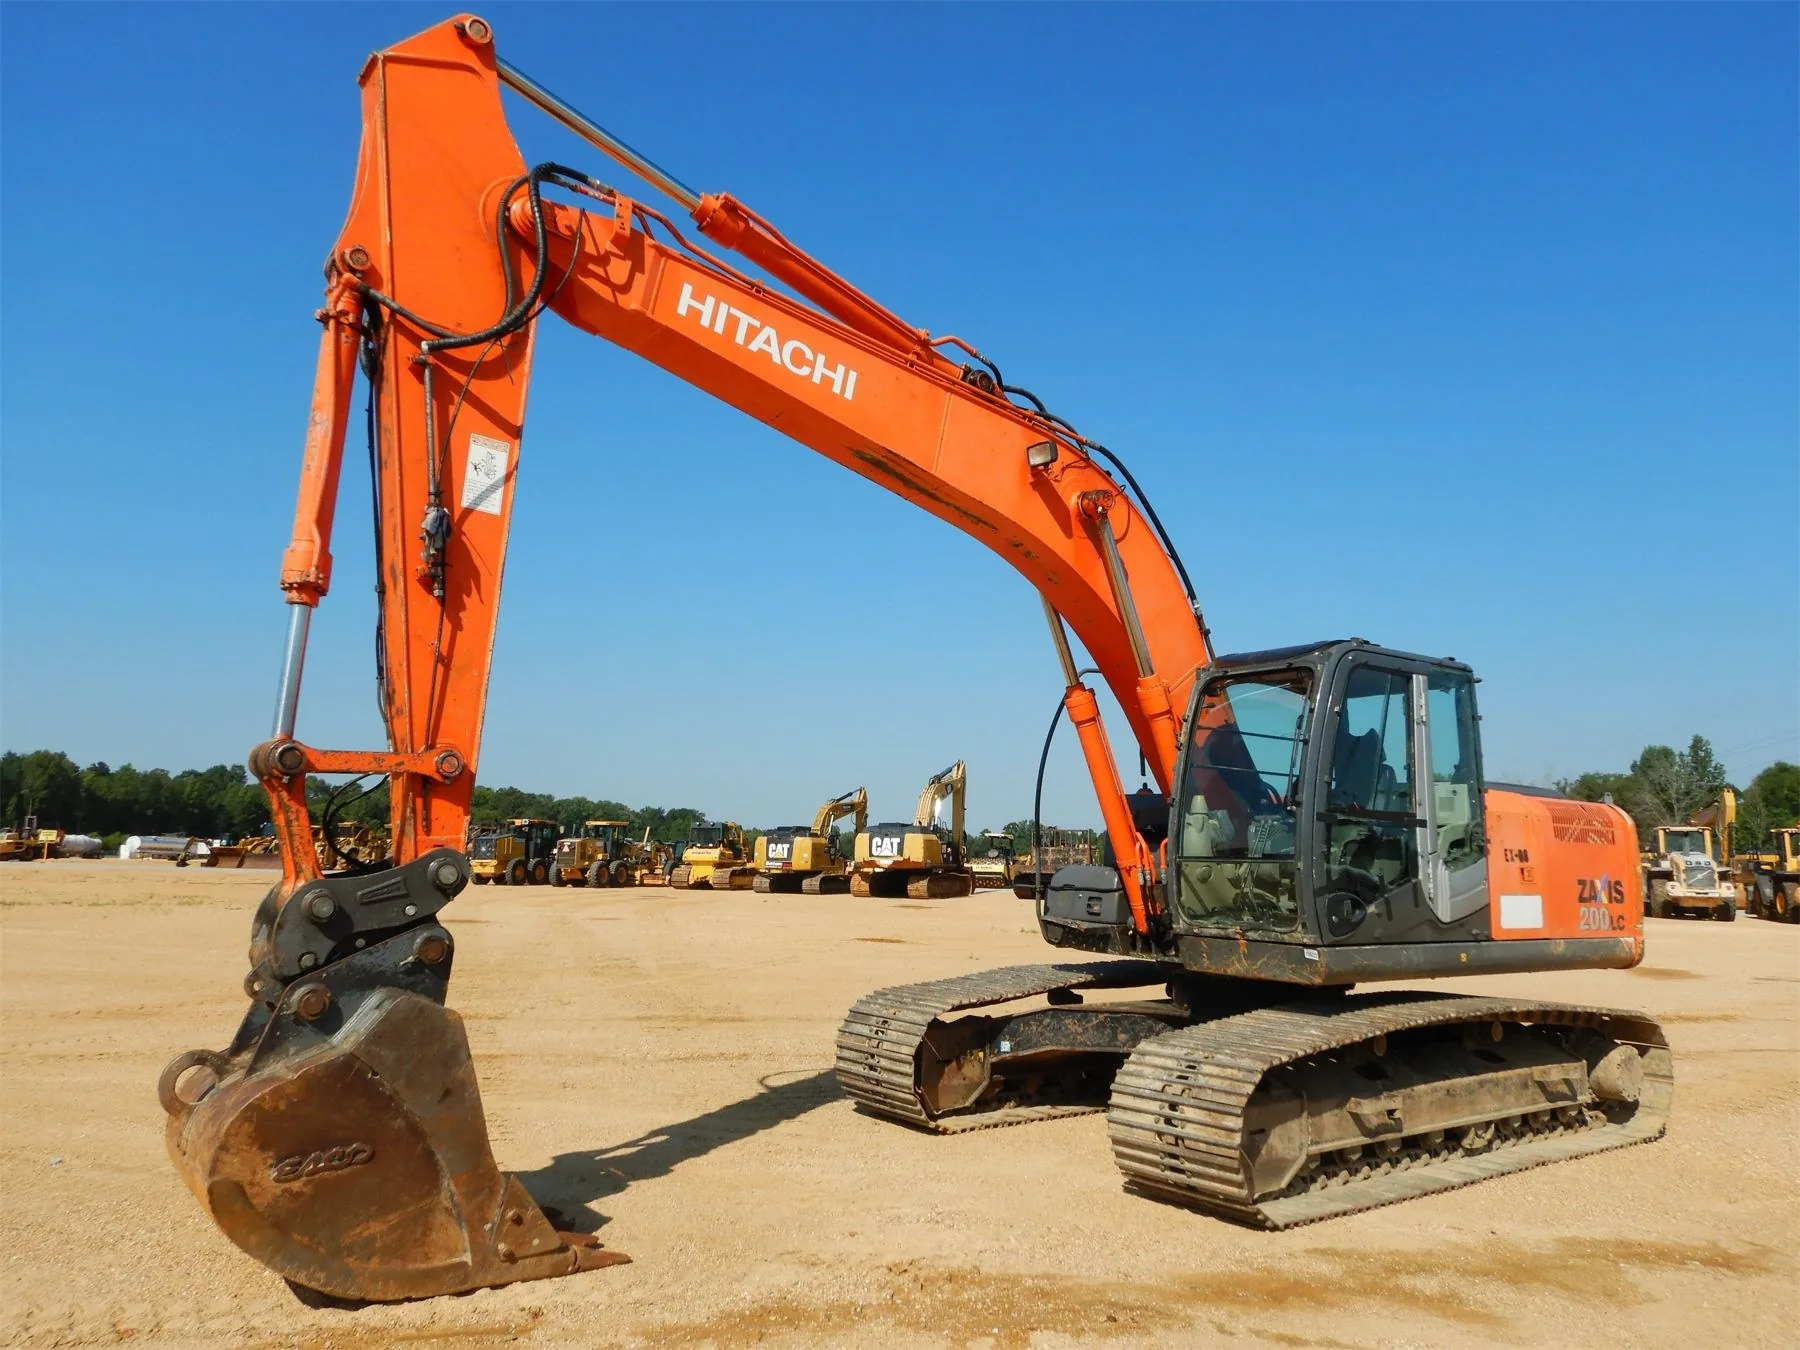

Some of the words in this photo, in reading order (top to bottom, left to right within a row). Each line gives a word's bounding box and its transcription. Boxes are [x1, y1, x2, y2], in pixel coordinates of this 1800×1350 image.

[677, 282, 857, 401] HITACHI
[768, 843, 791, 859] CAT
[871, 837, 901, 857] CAT
[1577, 873, 1625, 904] ZAXIS
